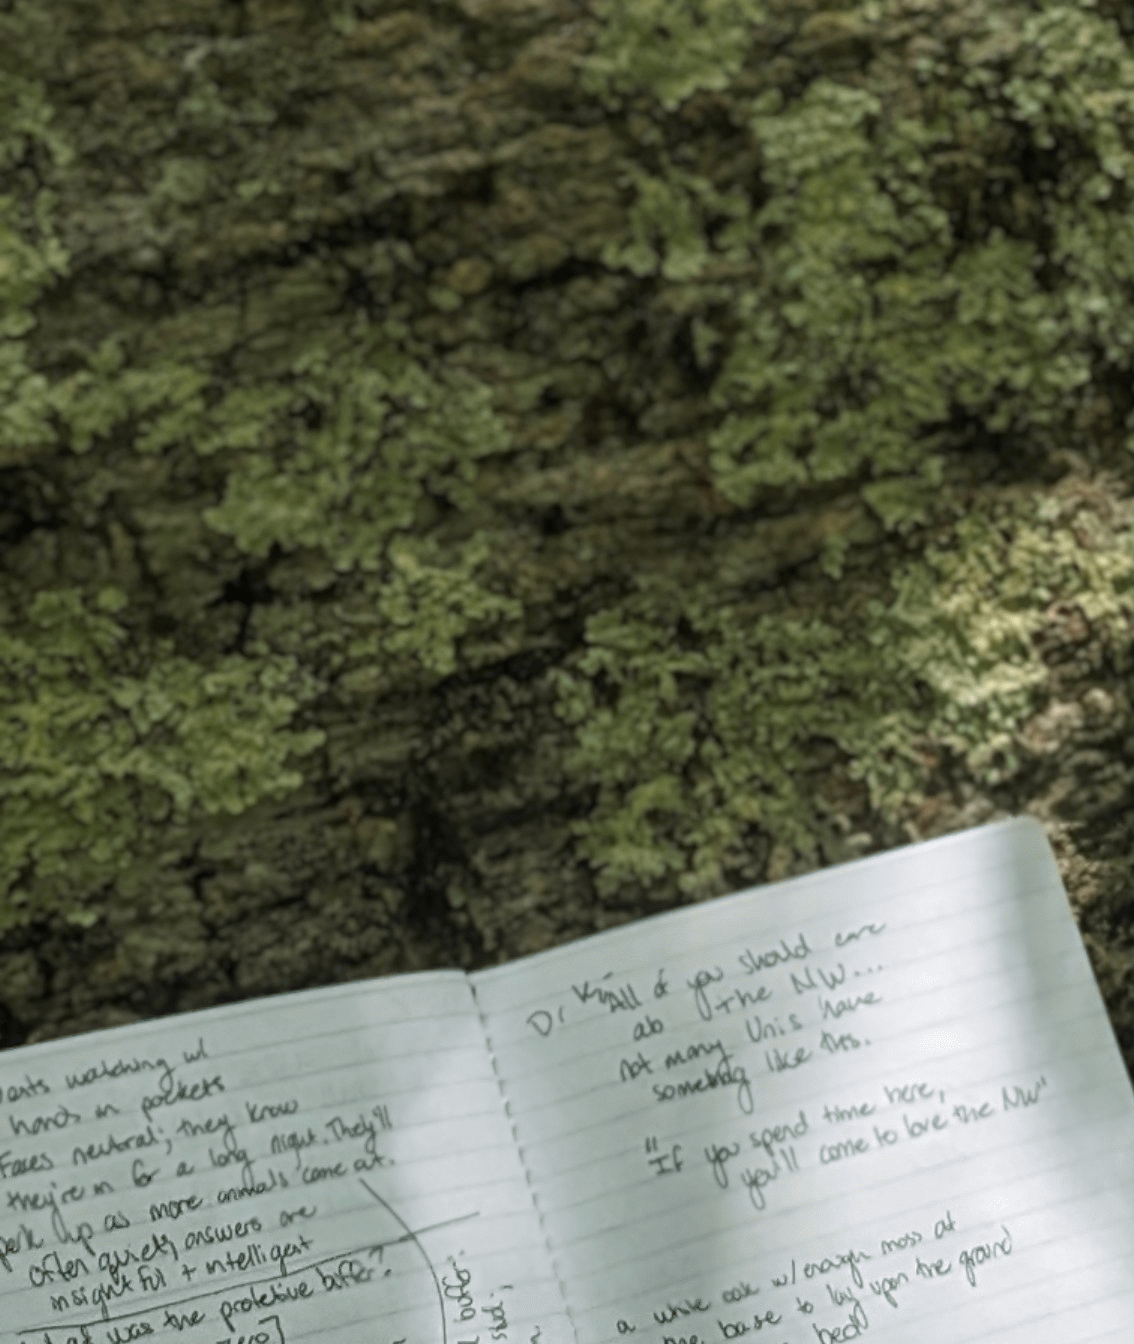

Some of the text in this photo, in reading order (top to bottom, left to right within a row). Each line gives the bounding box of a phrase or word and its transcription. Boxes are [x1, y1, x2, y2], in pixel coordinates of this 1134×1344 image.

[687, 966, 724, 1022] you
[739, 932, 812, 975] should
[664, 1040, 735, 1077] many
[818, 991, 883, 1019] have
[765, 1047, 814, 1073] like
[9, 1075, 226, 1136] hands in pockets
[66, 1058, 175, 1092] watching
[176, 1113, 237, 1153] they
[245, 1099, 299, 1124] know
[704, 1142, 740, 1189] you
[749, 1109, 809, 1158] spend
[823, 1102, 876, 1124] time
[883, 1082, 946, 1105] here,
[820, 1137, 870, 1164] come
[873, 1125, 898, 1147] to
[902, 1113, 949, 1139] love
[952, 1102, 995, 1124] the
[93, 1180, 115, 1196] in
[132, 1158, 161, 1188] for
[176, 1161, 195, 1178] a
[208, 1148, 256, 1190] long
[66, 1222, 96, 1257] up
[104, 1211, 130, 1232] as
[150, 1195, 203, 1222] more
[217, 1168, 289, 1204] animals
[302, 1162, 348, 1185] come
[185, 1215, 262, 1249] answers
[280, 1204, 317, 1227] are
[206, 1233, 313, 1277] intelligent
[616, 1318, 636, 1335] a
[721, 1281, 761, 1304] oak
[881, 1230, 923, 1255] moss
[934, 1210, 956, 1239] at
[163, 1309, 206, 1332] the
[717, 1310, 782, 1339] base
[796, 1296, 814, 1314] to
[869, 1271, 909, 1309] upon
[914, 1256, 951, 1278] the
